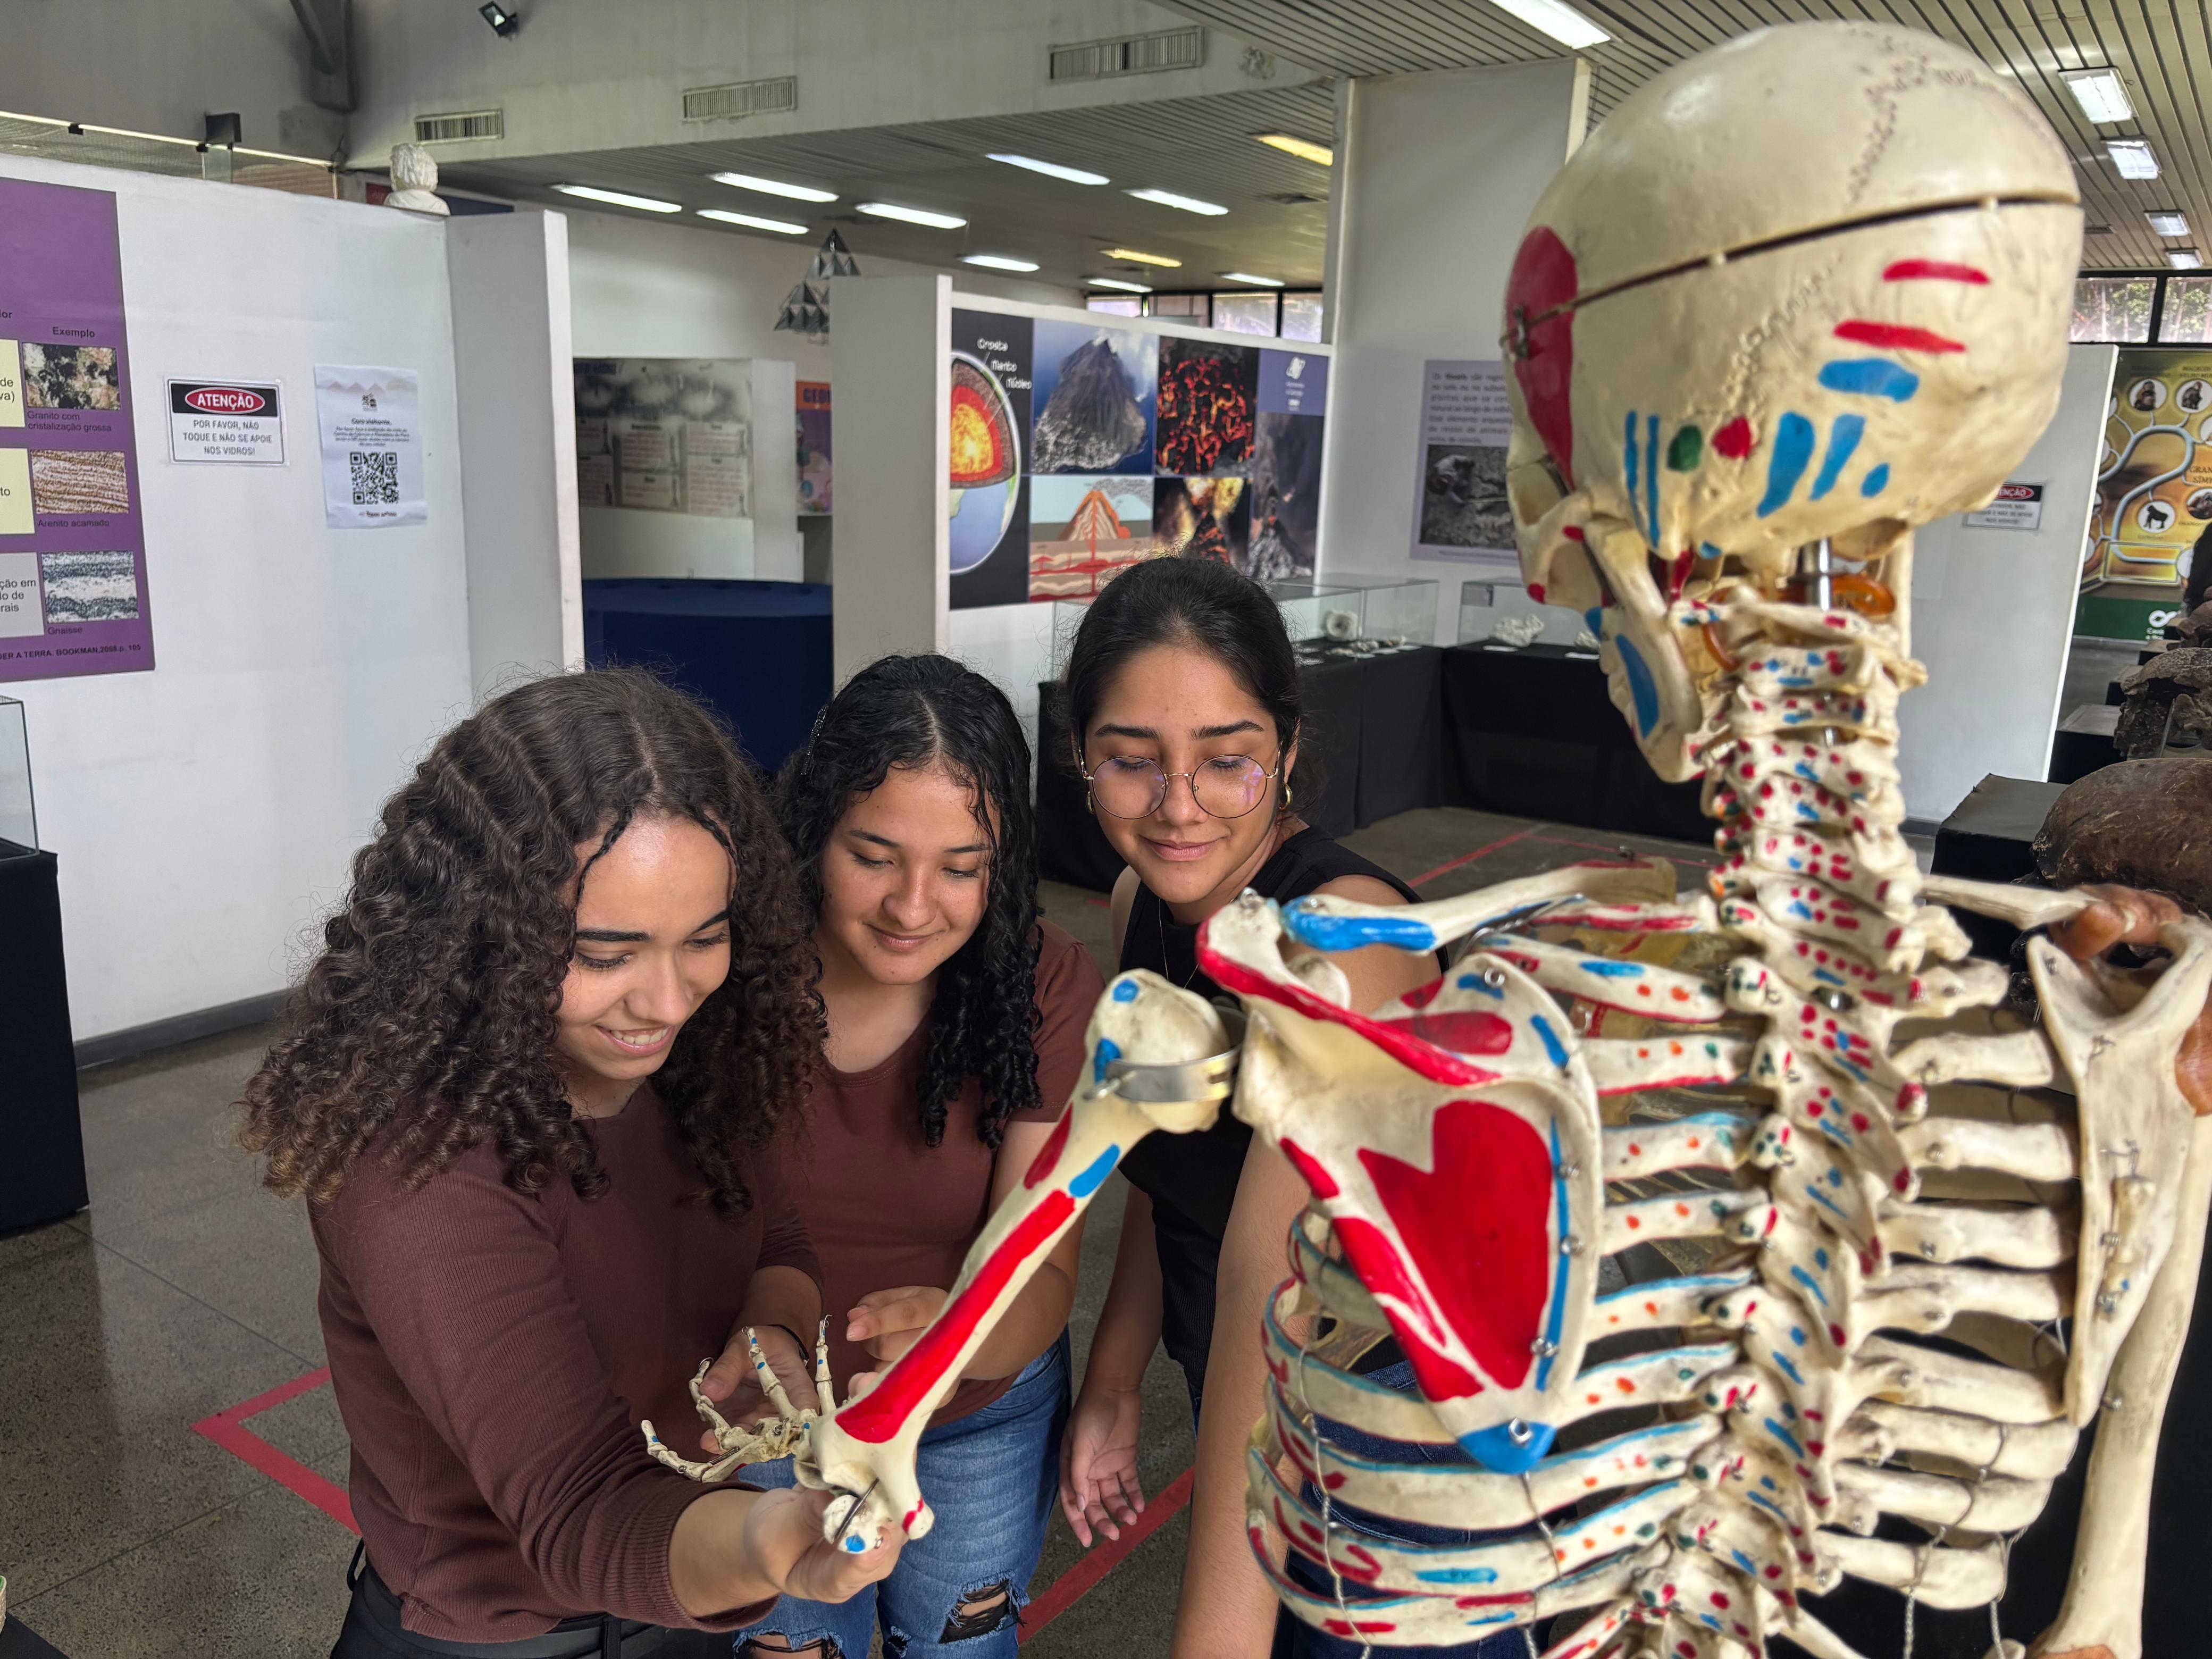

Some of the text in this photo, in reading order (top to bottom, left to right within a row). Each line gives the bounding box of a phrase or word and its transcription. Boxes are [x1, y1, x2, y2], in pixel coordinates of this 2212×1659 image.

[53, 327, 95, 338] Exemplo
[977, 338, 1008, 351] Crosta
[991, 359, 1017, 372] Manto
[0, 377, 13, 387] de
[1006, 376, 1032, 390] Núcleo
[197, 393, 254, 410] ATENÇÃO
[28, 411, 59, 420] Granito
[28, 423, 81, 433] cristalização
[194, 420, 259, 431] POR FAVOR, NÃO
[183, 432, 272, 443] TOQUE E NÃO SE APOIE
[204, 446, 255, 456] NOS VIDROS!
[1999, 487, 2027, 498] ENÇÃO
[38, 519, 69, 527] Arenito
[21, 580, 36, 588] em
[0, 590, 24, 600] o de
[1, 602, 19, 613] rais
[48, 626, 83, 635] Gnaisse
